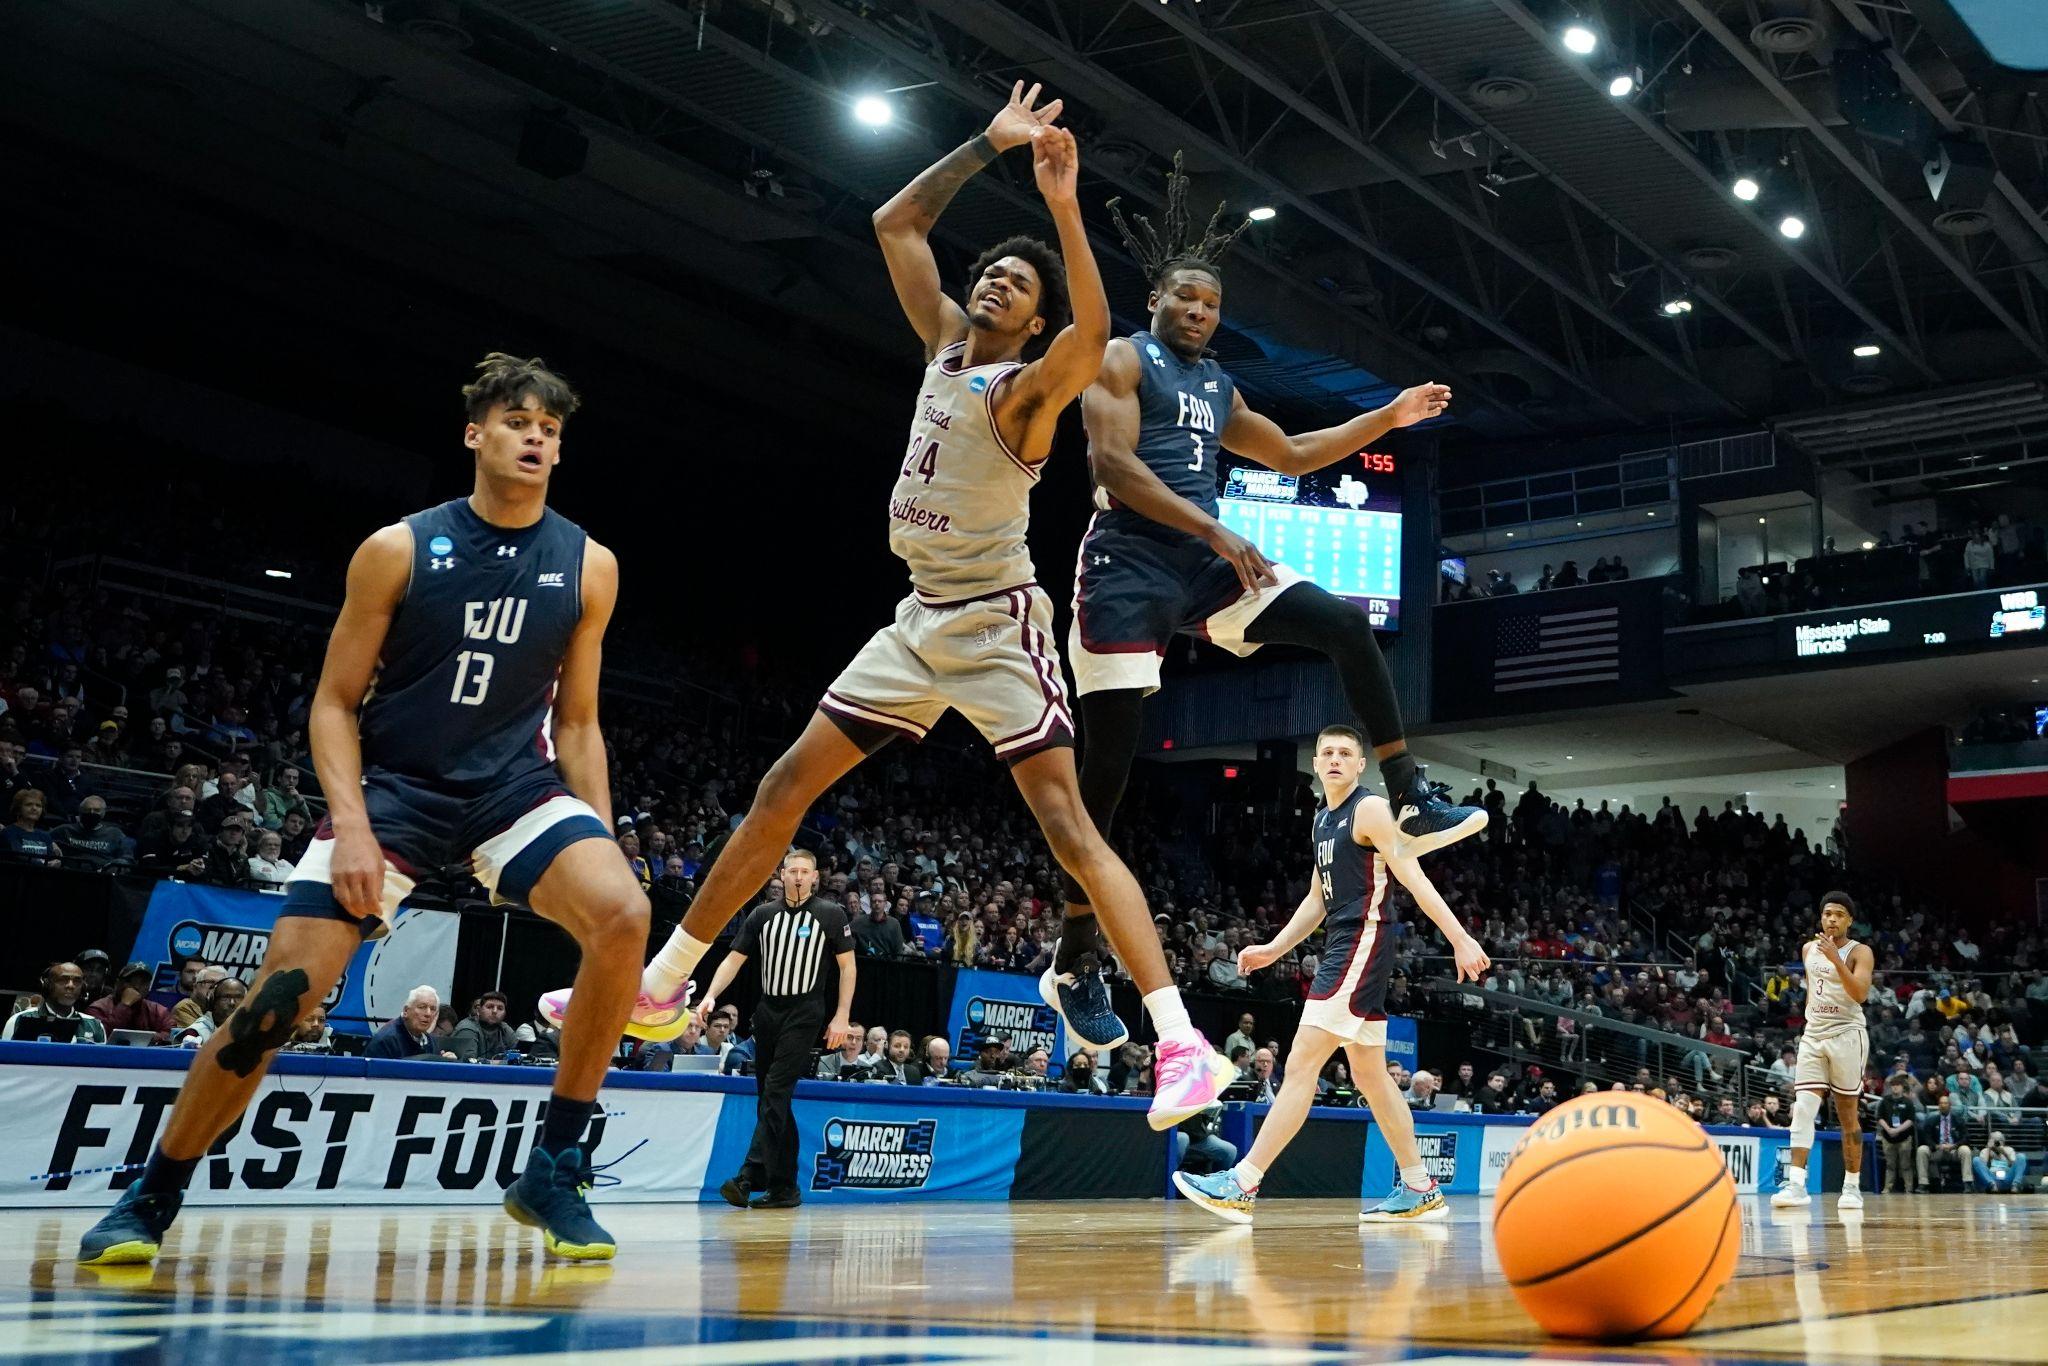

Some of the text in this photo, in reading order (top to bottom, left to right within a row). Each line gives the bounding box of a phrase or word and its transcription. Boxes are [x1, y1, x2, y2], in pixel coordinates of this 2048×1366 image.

[1177, 391, 1214, 433] FDU
[902, 436, 940, 484] 24
[1187, 432, 1204, 472] 3
[1360, 452, 1394, 472] 7:55
[538, 572, 564, 583] NEC
[1796, 617, 1890, 642] Mississippi State
[1923, 632, 1946, 643] 7:00
[1797, 638, 1847, 656] Illinois
[450, 650, 495, 706] 13
[1317, 838, 1335, 868] FDU
[175, 939, 202, 950] NCAA
[201, 931, 269, 966] MAR
[1816, 978, 1825, 996] 3
[984, 1003, 1035, 1029] MARCH
[844, 1125, 905, 1152] MARCH
[1416, 1137, 1441, 1156] ARCH
[847, 1152, 931, 1179] MADNESS
[1719, 1144, 1752, 1184] TON
